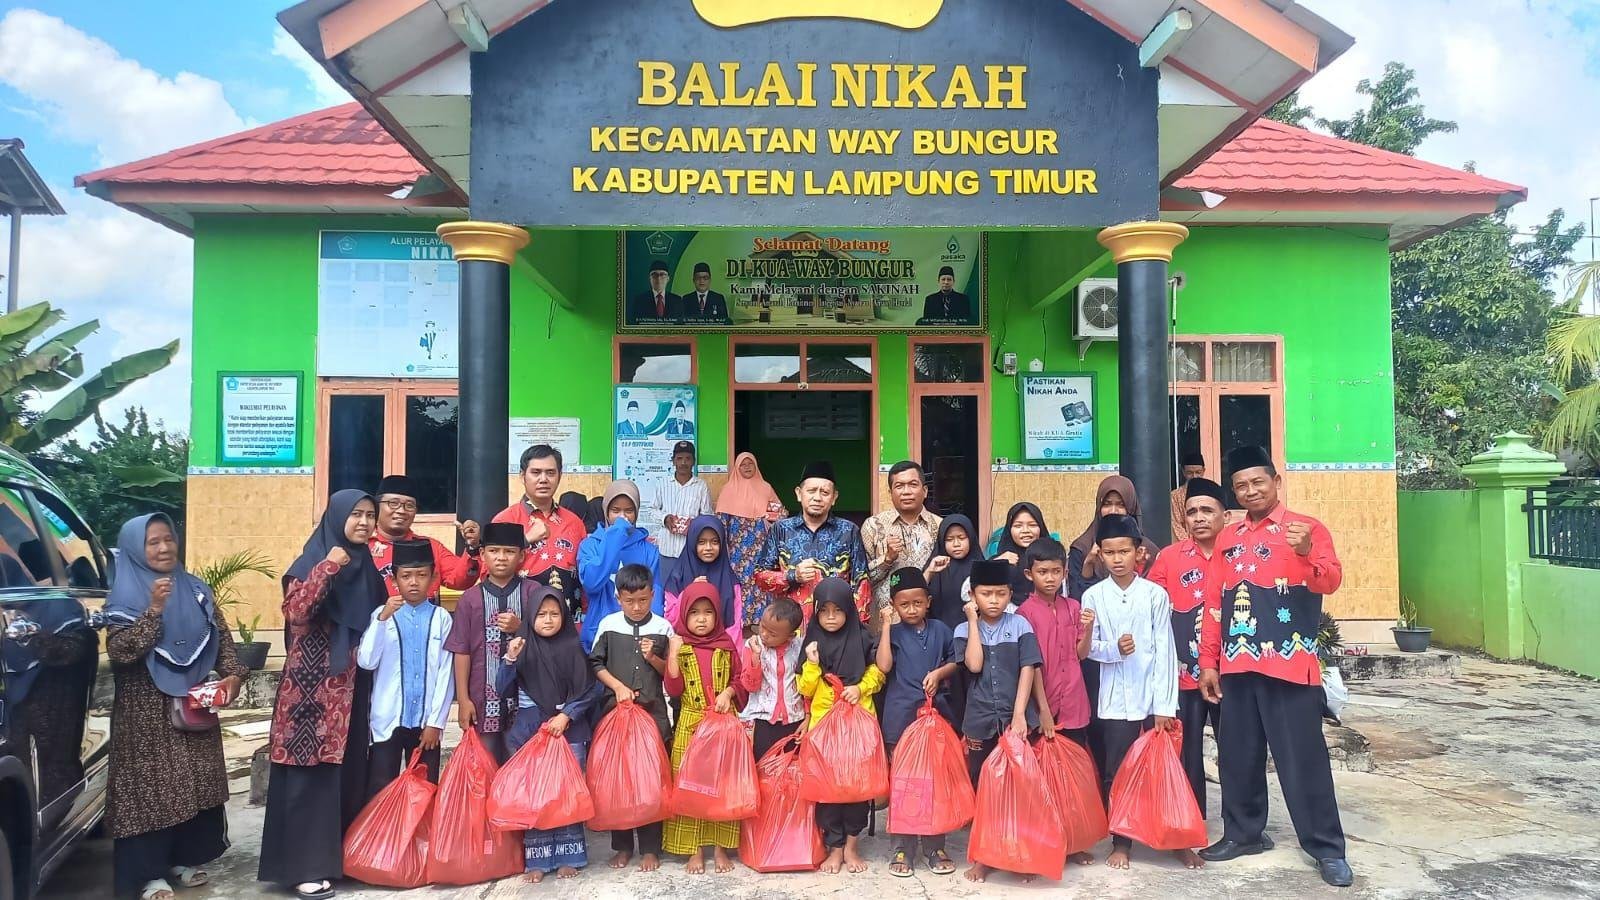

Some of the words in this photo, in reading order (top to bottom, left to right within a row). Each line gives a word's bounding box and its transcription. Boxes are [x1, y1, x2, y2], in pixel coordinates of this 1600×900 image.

[637, 61, 818, 107] BALAI
[830, 63, 1028, 109] NIKAH
[590, 127, 816, 153] KECAMATAN
[827, 129, 901, 155] WAY
[913, 129, 1059, 155] BUNGUR
[572, 167, 795, 195] KABUPATEN
[803, 169, 981, 196] LAMPUNG
[989, 169, 1099, 194] TIMUR
[390, 236, 413, 246] ALUR
[414, 236, 447, 247] PELAYA
[752, 236, 823, 254] Selamat
[823, 237, 890, 255] Datang
[726, 259, 746, 278] DI
[751, 259, 790, 278] KUA
[794, 259, 834, 278] WAY
[838, 259, 916, 278] BUNGUR
[730, 283, 761, 295] Kami
[763, 283, 815, 298] Melayani
[817, 282, 859, 298] dengan
[861, 284, 920, 295] SAKINAH
[1027, 376, 1065, 385] PASTIKAN
[1027, 386, 1053, 395] NIKAH
[1055, 386, 1077, 395] ANDA
